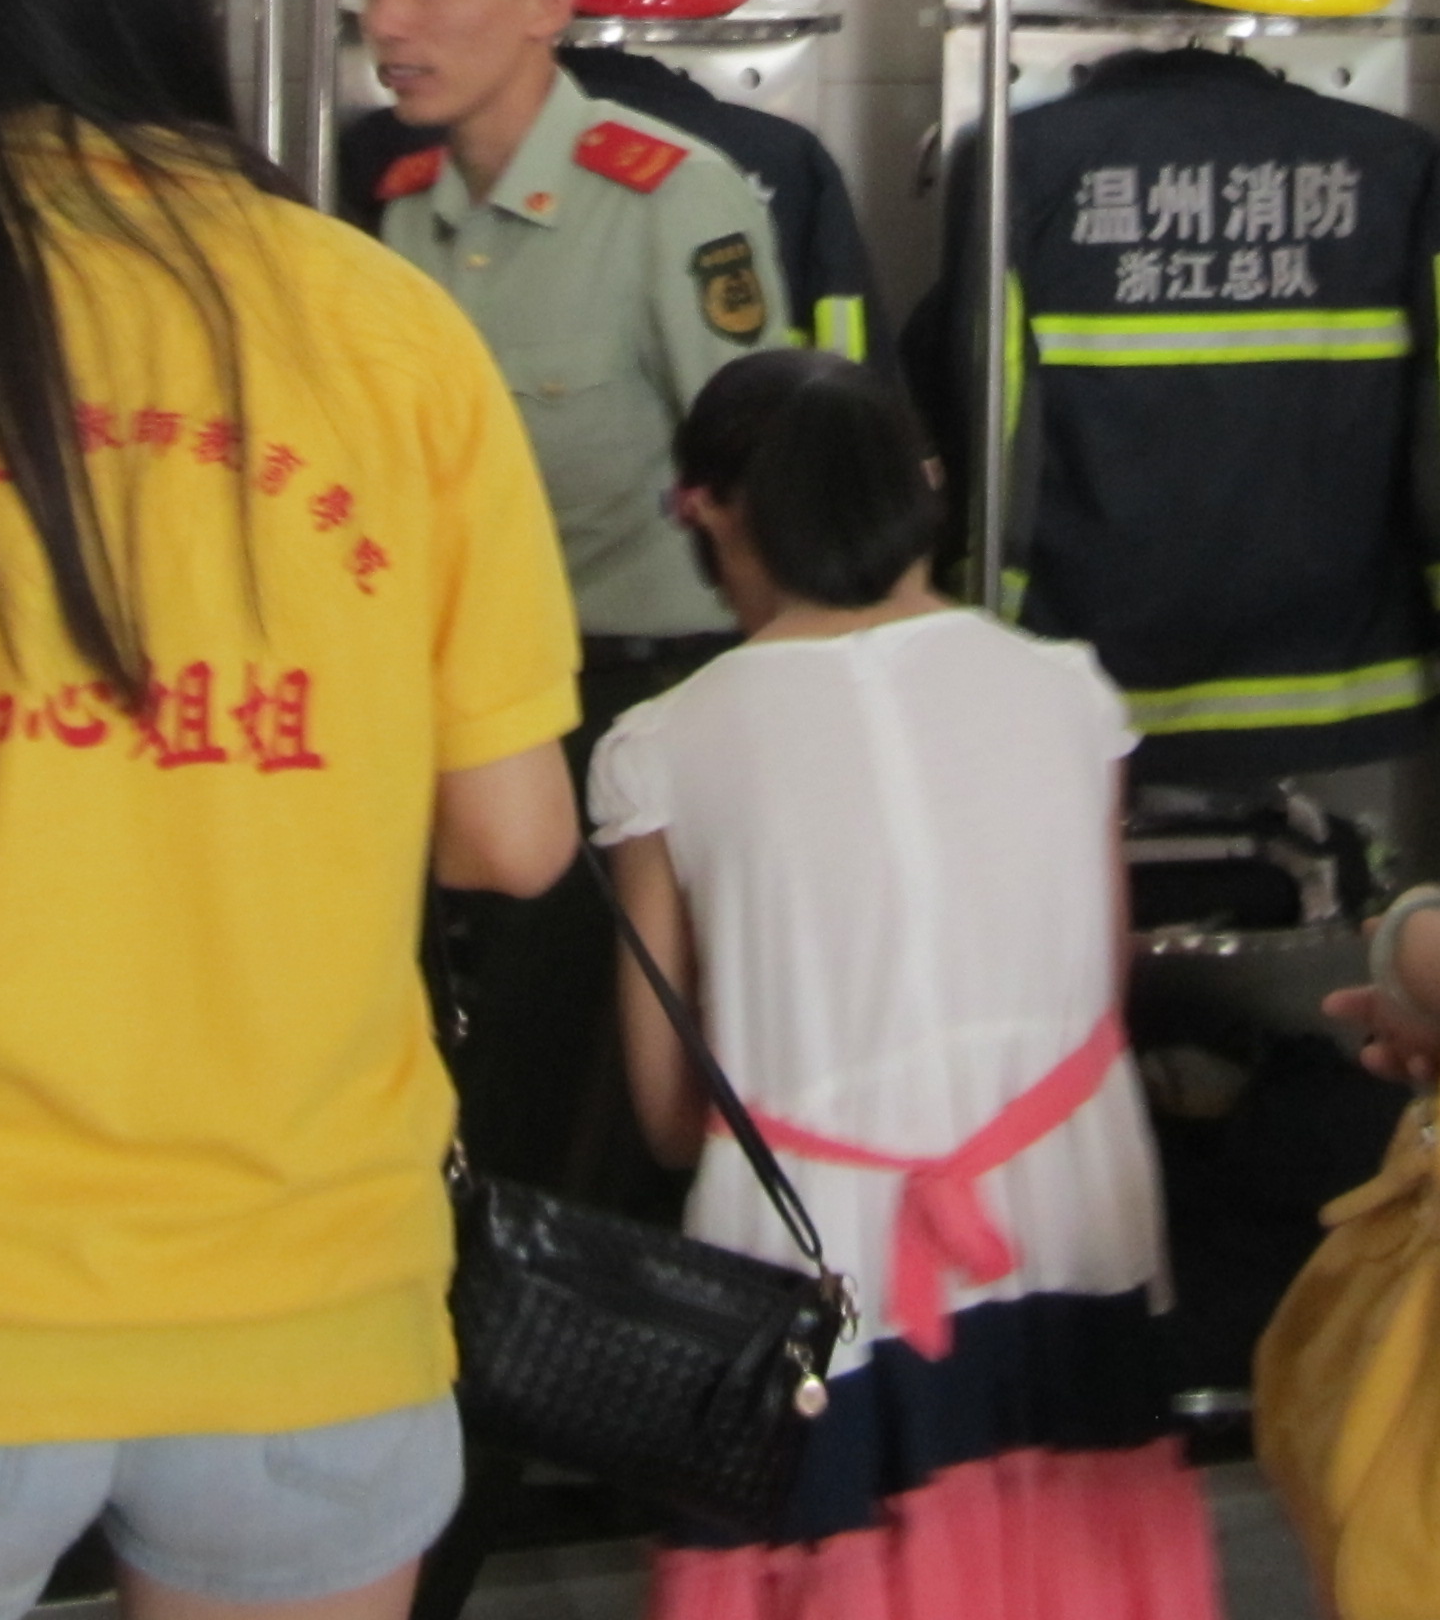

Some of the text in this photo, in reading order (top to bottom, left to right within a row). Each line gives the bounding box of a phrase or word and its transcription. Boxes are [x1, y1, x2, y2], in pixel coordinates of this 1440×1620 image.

[1070, 157, 1361, 246] 温州消防
[1114, 243, 1319, 303] 浙江总队
